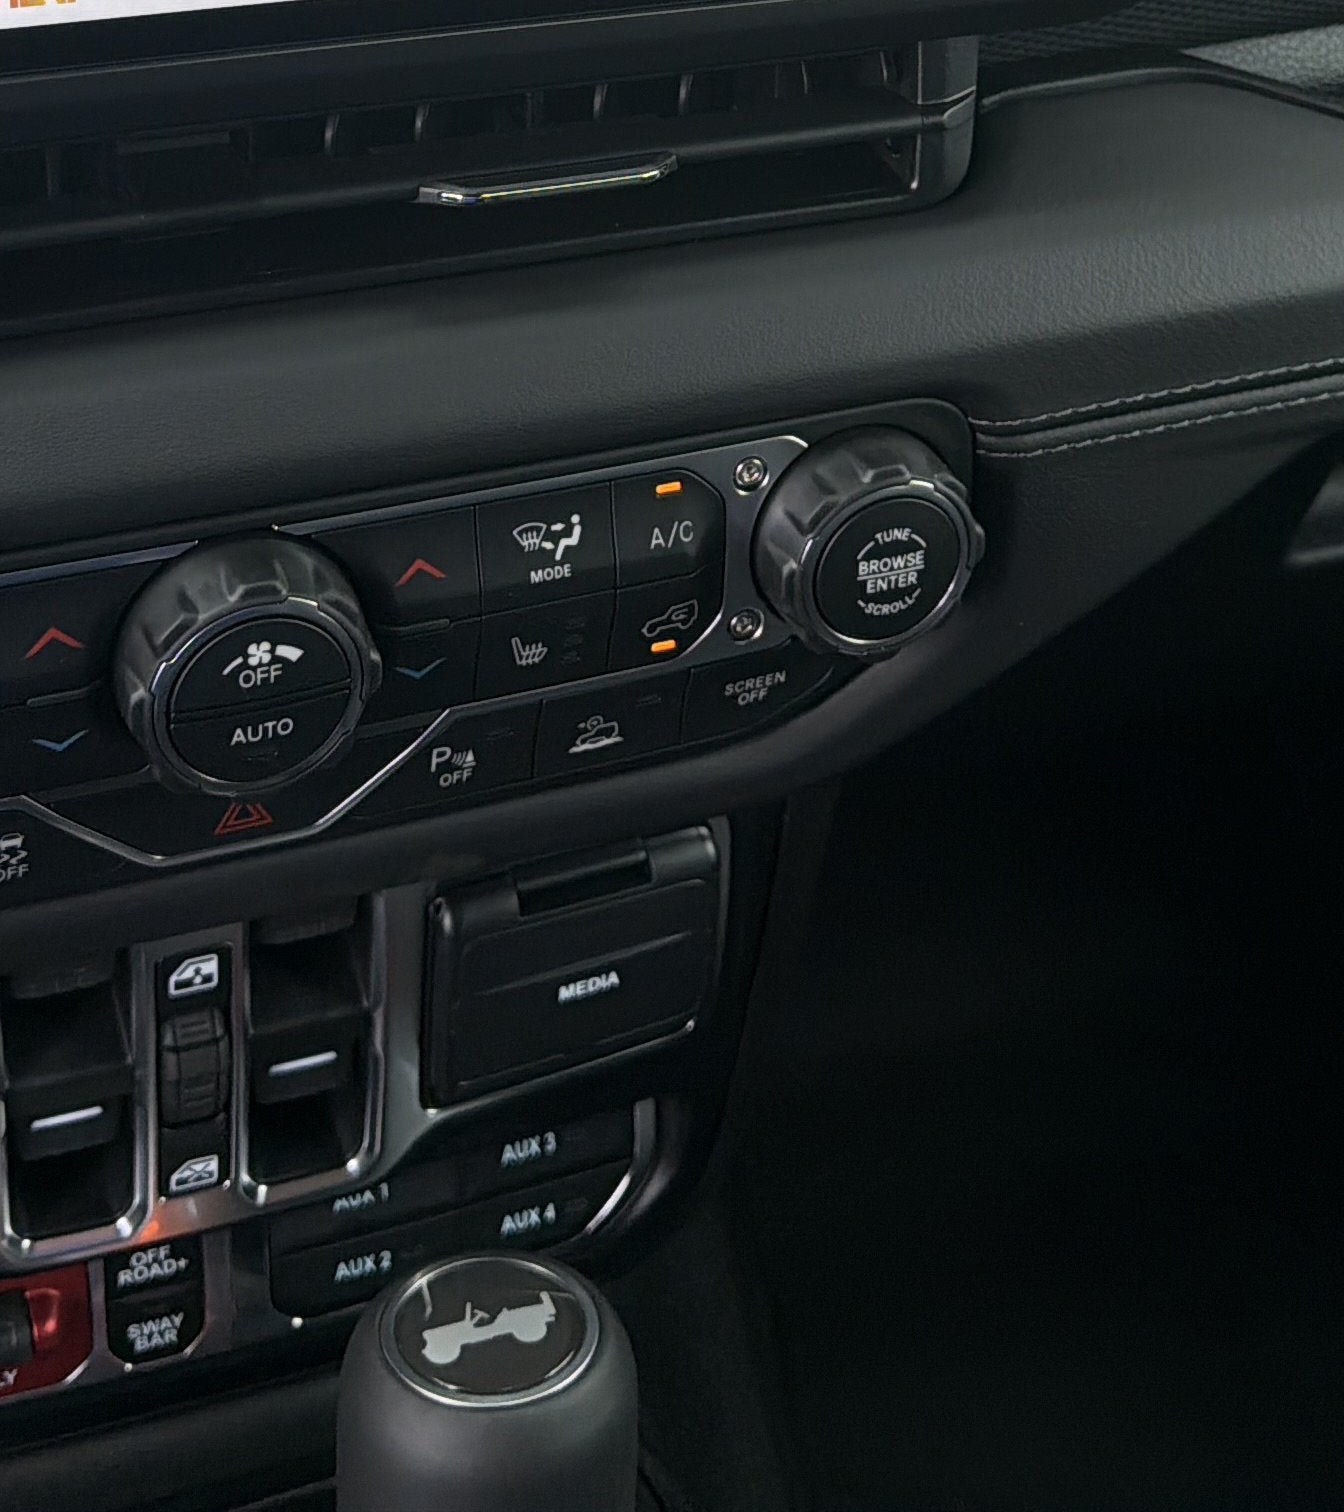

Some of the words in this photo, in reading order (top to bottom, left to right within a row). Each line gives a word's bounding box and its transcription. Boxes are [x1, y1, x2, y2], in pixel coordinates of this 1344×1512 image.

[650, 521, 695, 550] A/C
[875, 526, 913, 545] TUNE
[530, 564, 572, 585] MODE
[857, 550, 925, 576] BROWSE
[865, 571, 918, 595] ENTER
[862, 594, 917, 617] SCROLL
[238, 664, 284, 690] OFF
[724, 670, 787, 695] SCREEN
[736, 688, 769, 707] OFF
[230, 718, 294, 746] AUTO
[439, 766, 474, 788] OFF
[558, 970, 620, 1002] MEDIA
[501, 1134, 542, 1169] AUX
[543, 1131, 557, 1156] 3
[501, 1205, 542, 1237] AUX
[543, 1202, 556, 1225] 4
[129, 1245, 172, 1268] OFF
[334, 1252, 377, 1283] AUX
[379, 1249, 393, 1273] 2
[116, 1257, 190, 1289] ROAD+
[126, 1312, 185, 1339] SWAY
[133, 1328, 178, 1354] BAR
